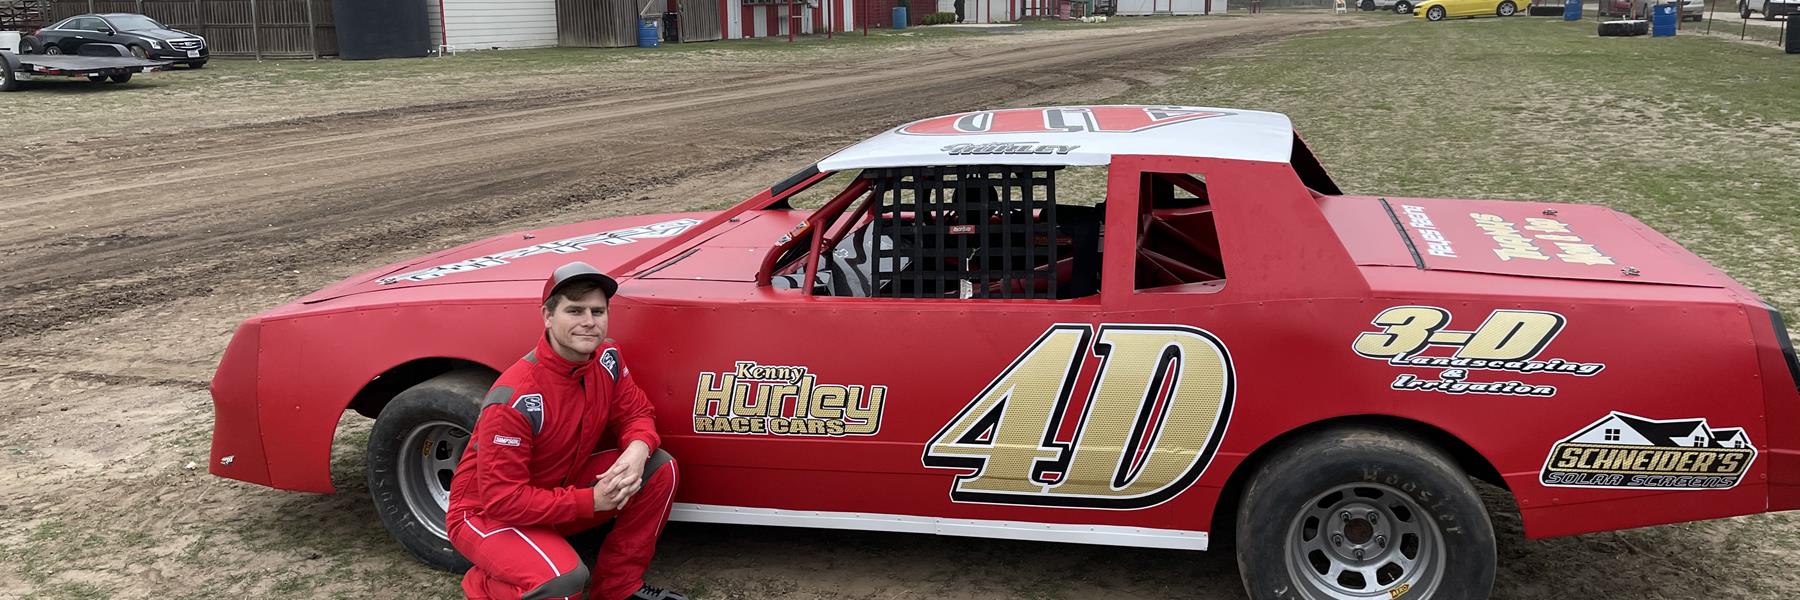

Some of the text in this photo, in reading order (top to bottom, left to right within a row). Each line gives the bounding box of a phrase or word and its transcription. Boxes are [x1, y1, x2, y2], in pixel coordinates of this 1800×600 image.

[1352, 306, 1566, 360] 3-D
[737, 362, 805, 385] Kenny
[1391, 352, 1605, 376] Landscaping
[1441, 368, 1467, 381] &
[1393, 375, 1556, 396] Irrigation
[694, 373, 886, 434] Hurley
[695, 416, 846, 436] RACE CARS
[922, 323, 1236, 510] 4D
[1557, 446, 1744, 473] SCHNEIDER'S
[1544, 472, 1738, 489] SOLAR SCREENS
